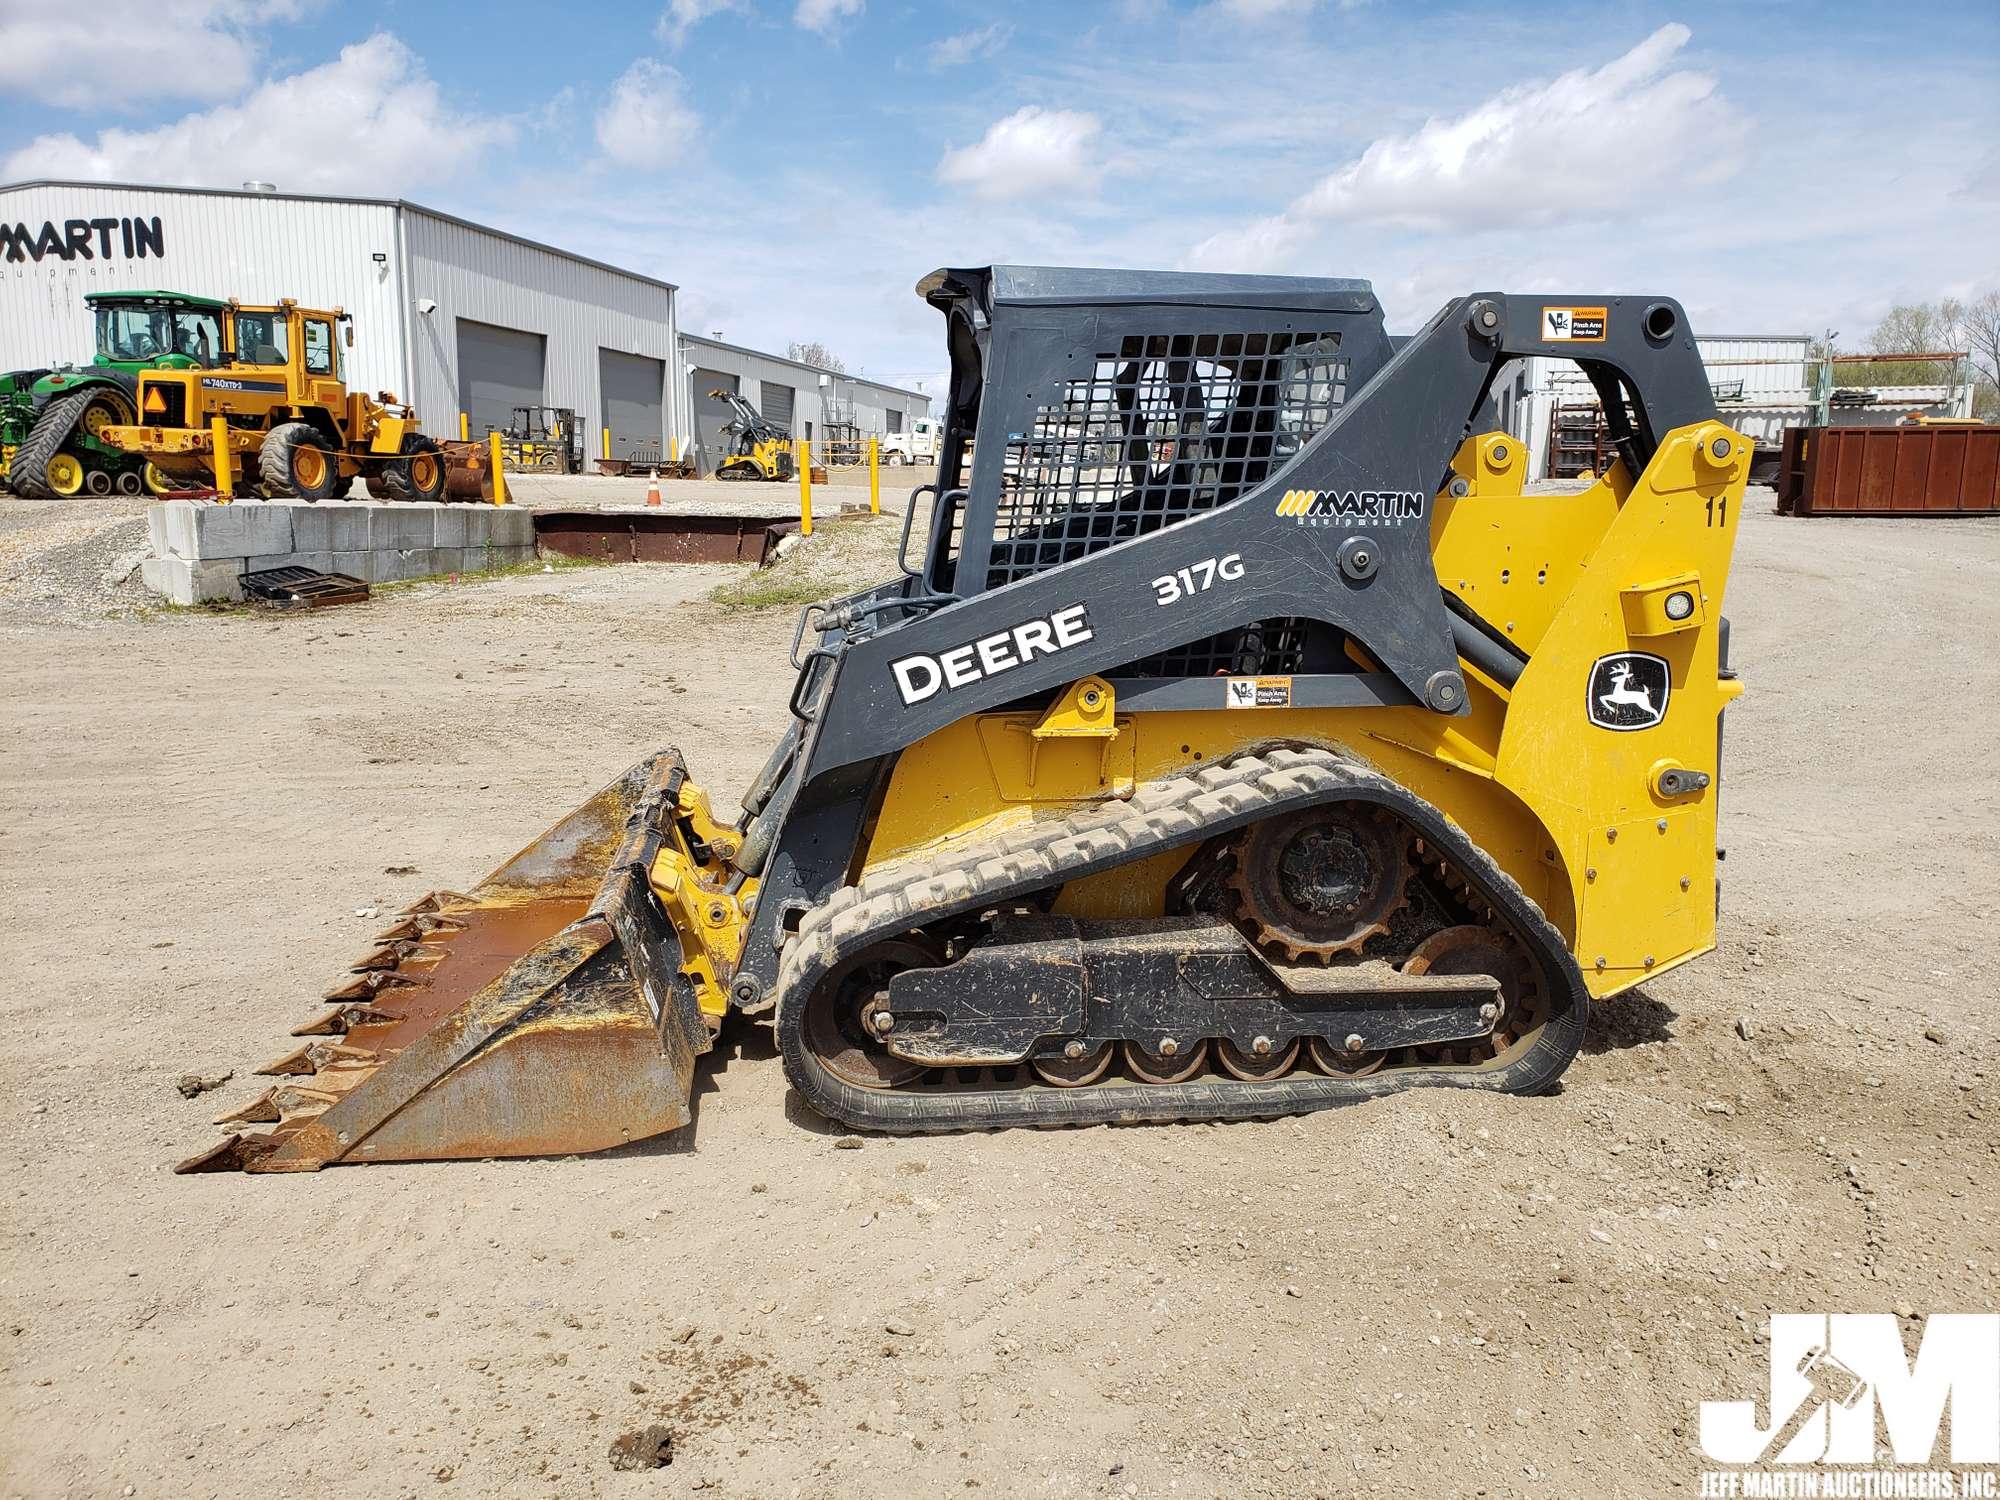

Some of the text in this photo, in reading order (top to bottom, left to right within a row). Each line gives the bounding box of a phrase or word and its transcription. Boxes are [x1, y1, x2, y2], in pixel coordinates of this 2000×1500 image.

[0, 216, 164, 263] MARTIN
[1308, 491, 1424, 518] MARTIN
[1705, 496, 1727, 527] 11
[1151, 553, 1246, 606] 317G
[892, 603, 1095, 705] DEERE
